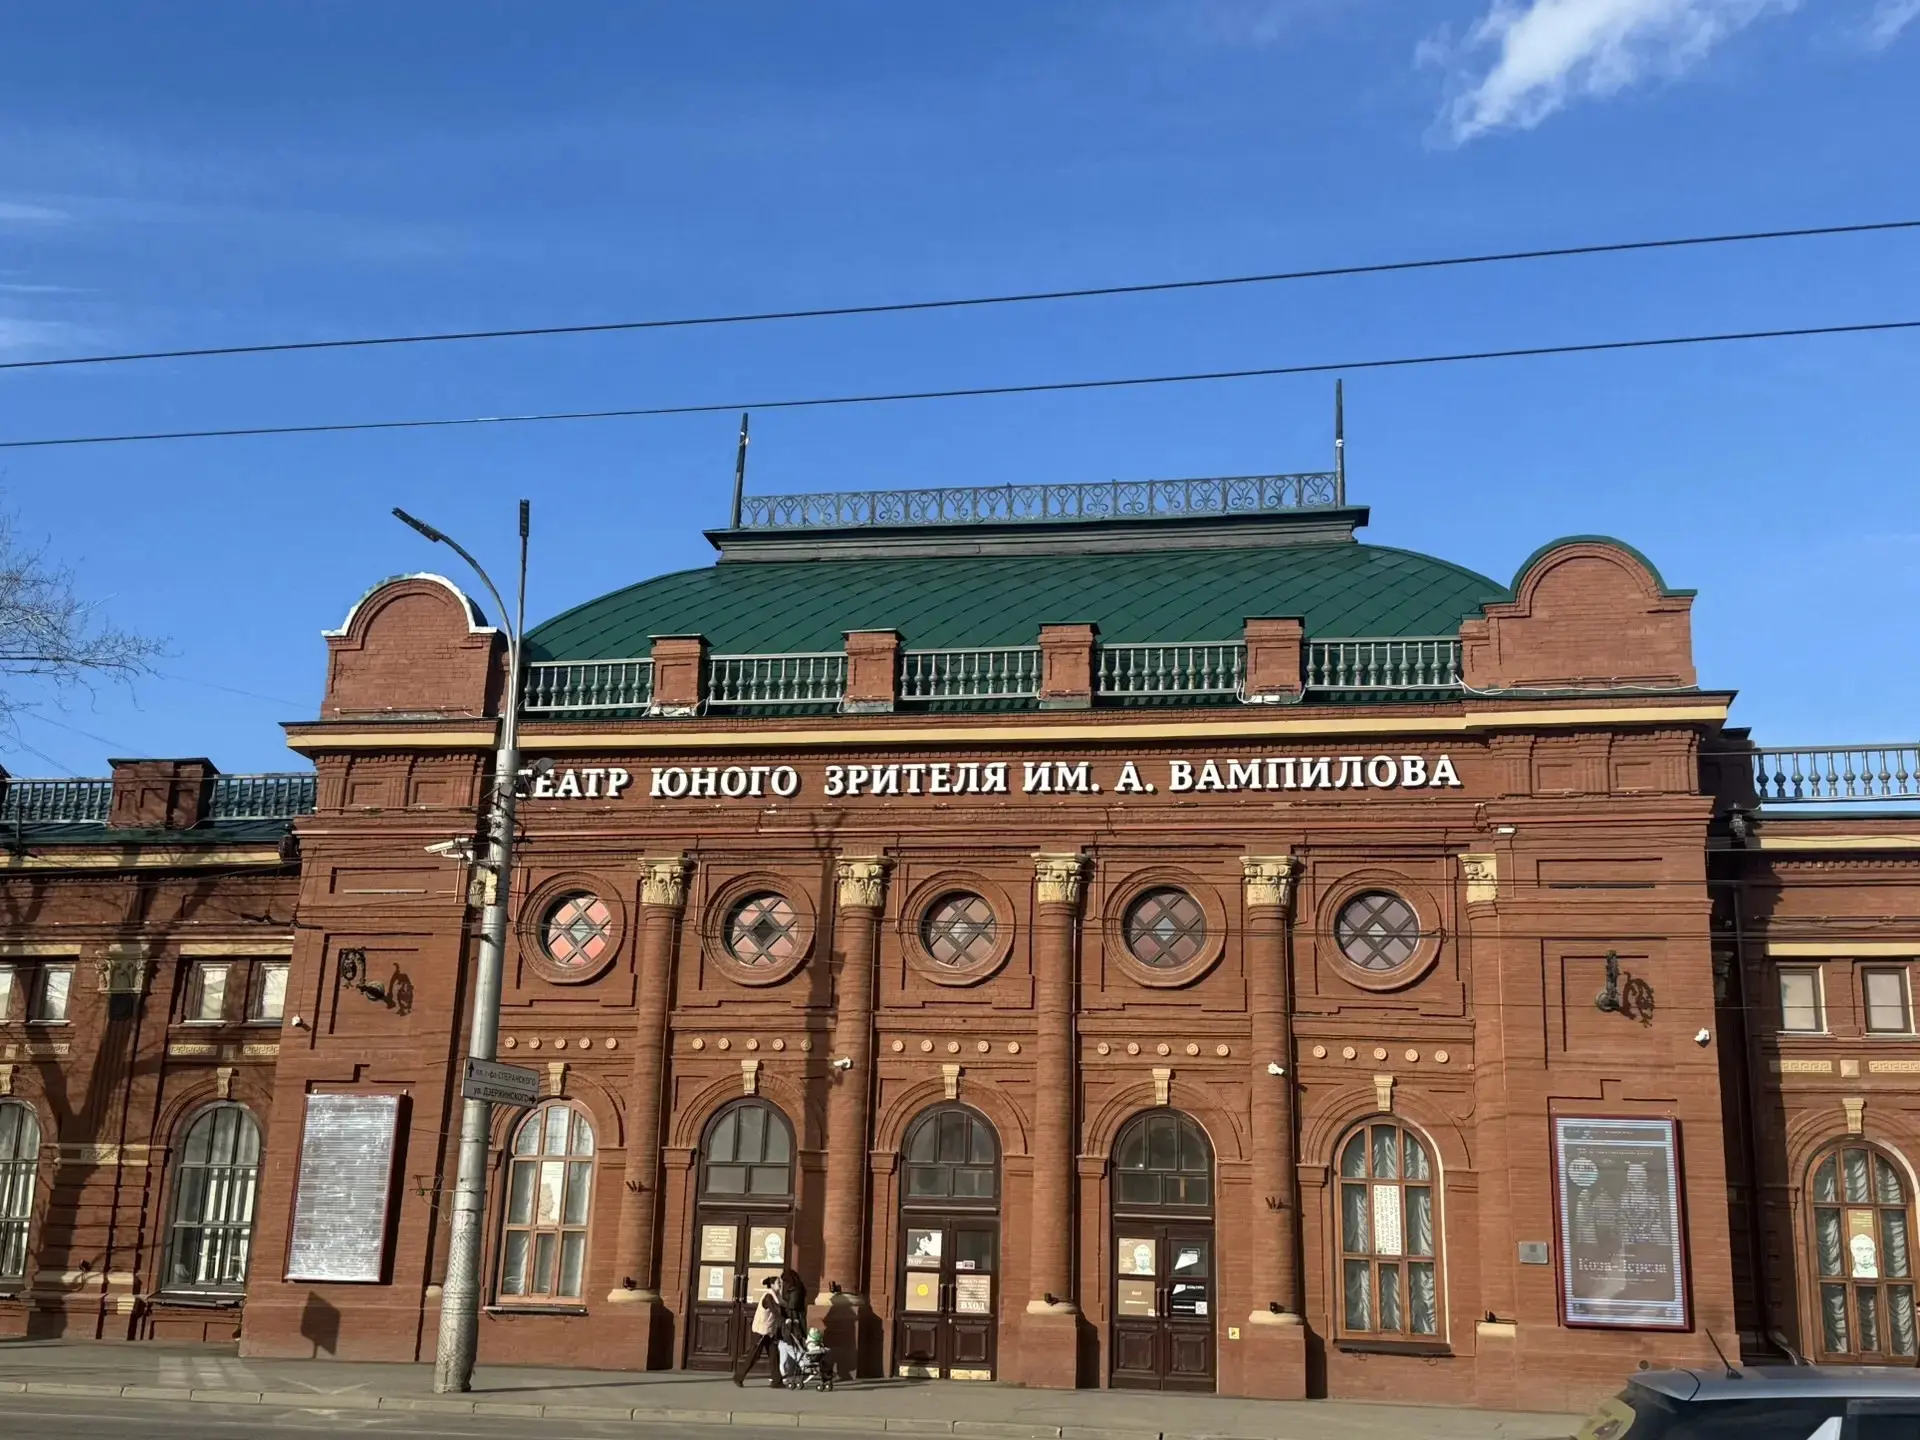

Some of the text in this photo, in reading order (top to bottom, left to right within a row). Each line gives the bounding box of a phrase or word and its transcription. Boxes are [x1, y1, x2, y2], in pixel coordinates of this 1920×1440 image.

[649, 766, 798, 796] ЮНОГО
[824, 762, 1007, 796] ЗРИТЕЛЯ
[1022, 761, 1100, 792] ИМ.
[1114, 761, 1154, 792] А.
[1168, 755, 1462, 791] ВАМПИЛОВА
[483, 1087, 528, 1102] ДЗЕРЖИНСКОГО
